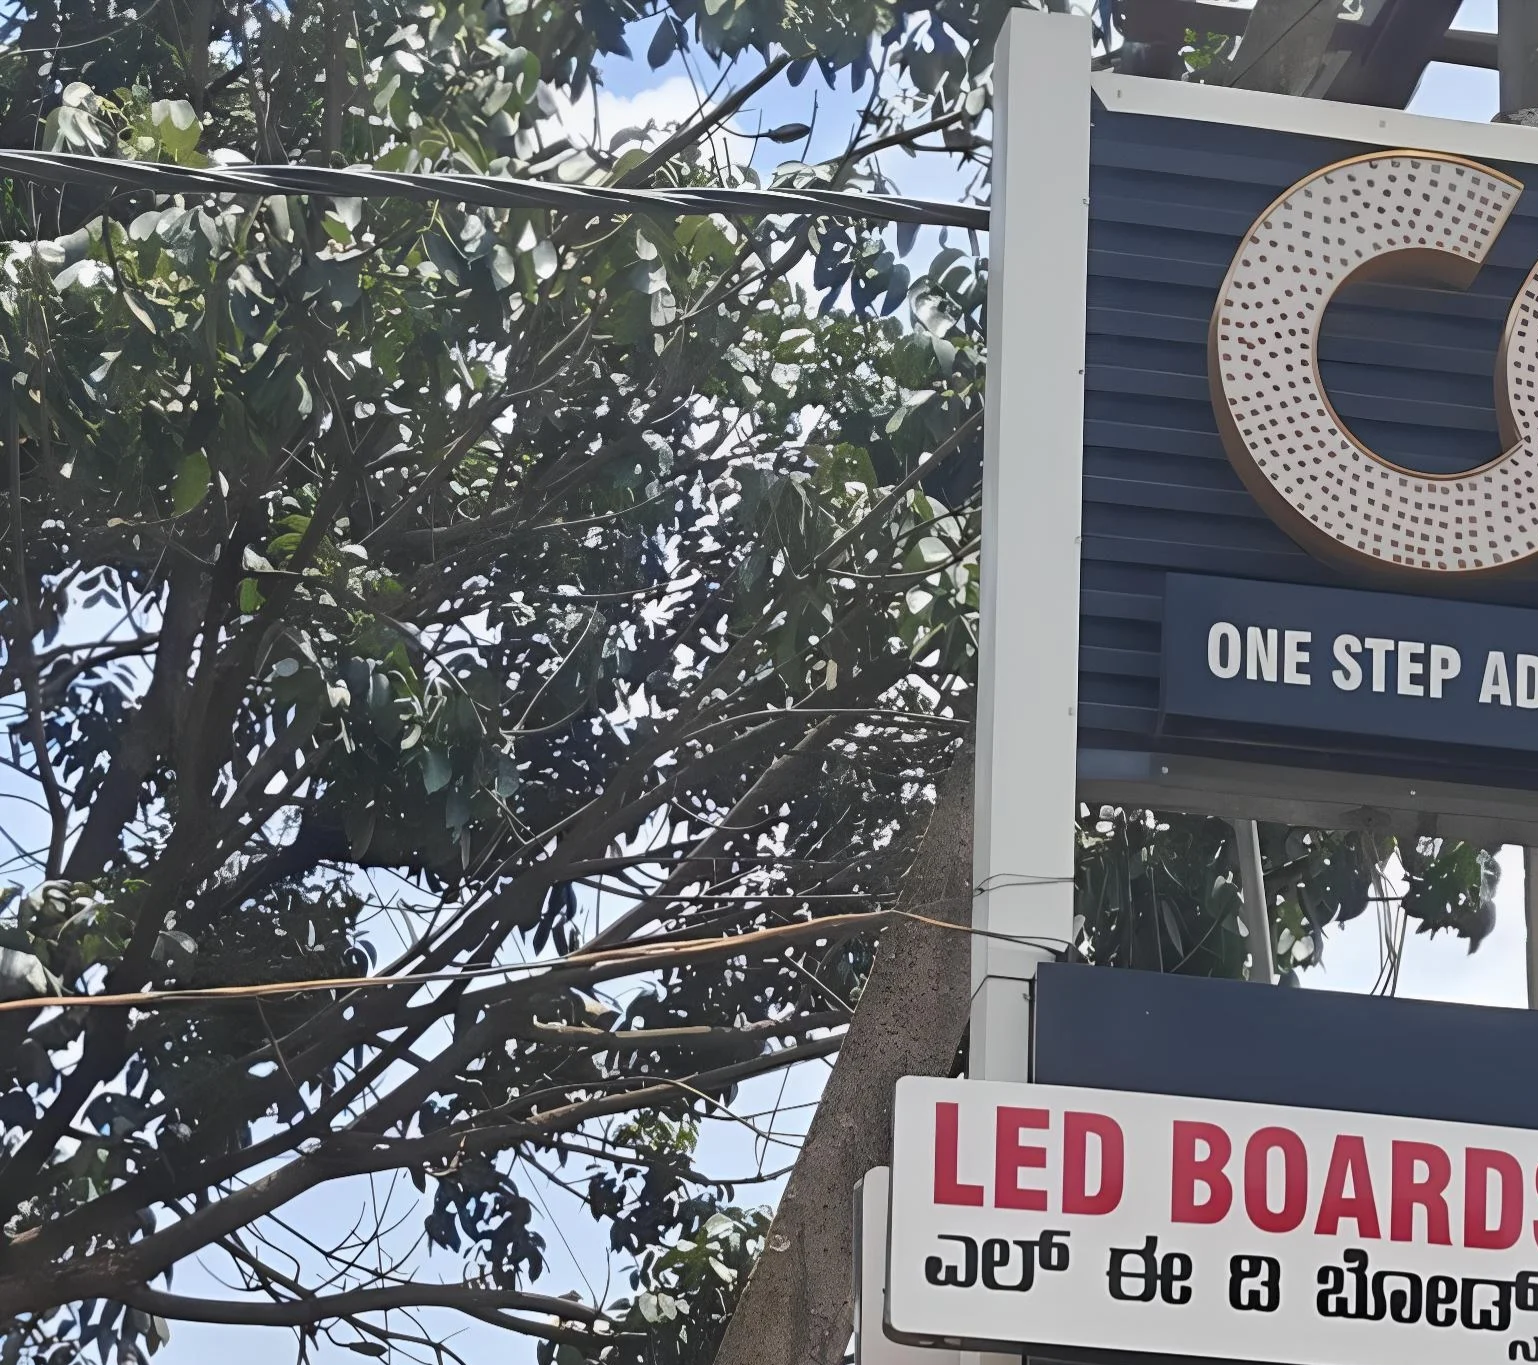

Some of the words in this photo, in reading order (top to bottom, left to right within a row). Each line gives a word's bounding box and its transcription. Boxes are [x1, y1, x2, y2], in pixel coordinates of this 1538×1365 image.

[1207, 621, 1312, 686] ONE
[1332, 634, 1462, 700] STEP
[932, 1101, 1126, 1217] LED
[924, 1228, 1071, 1293] ಎಲ್
[1107, 1235, 1193, 1305] ಈ
